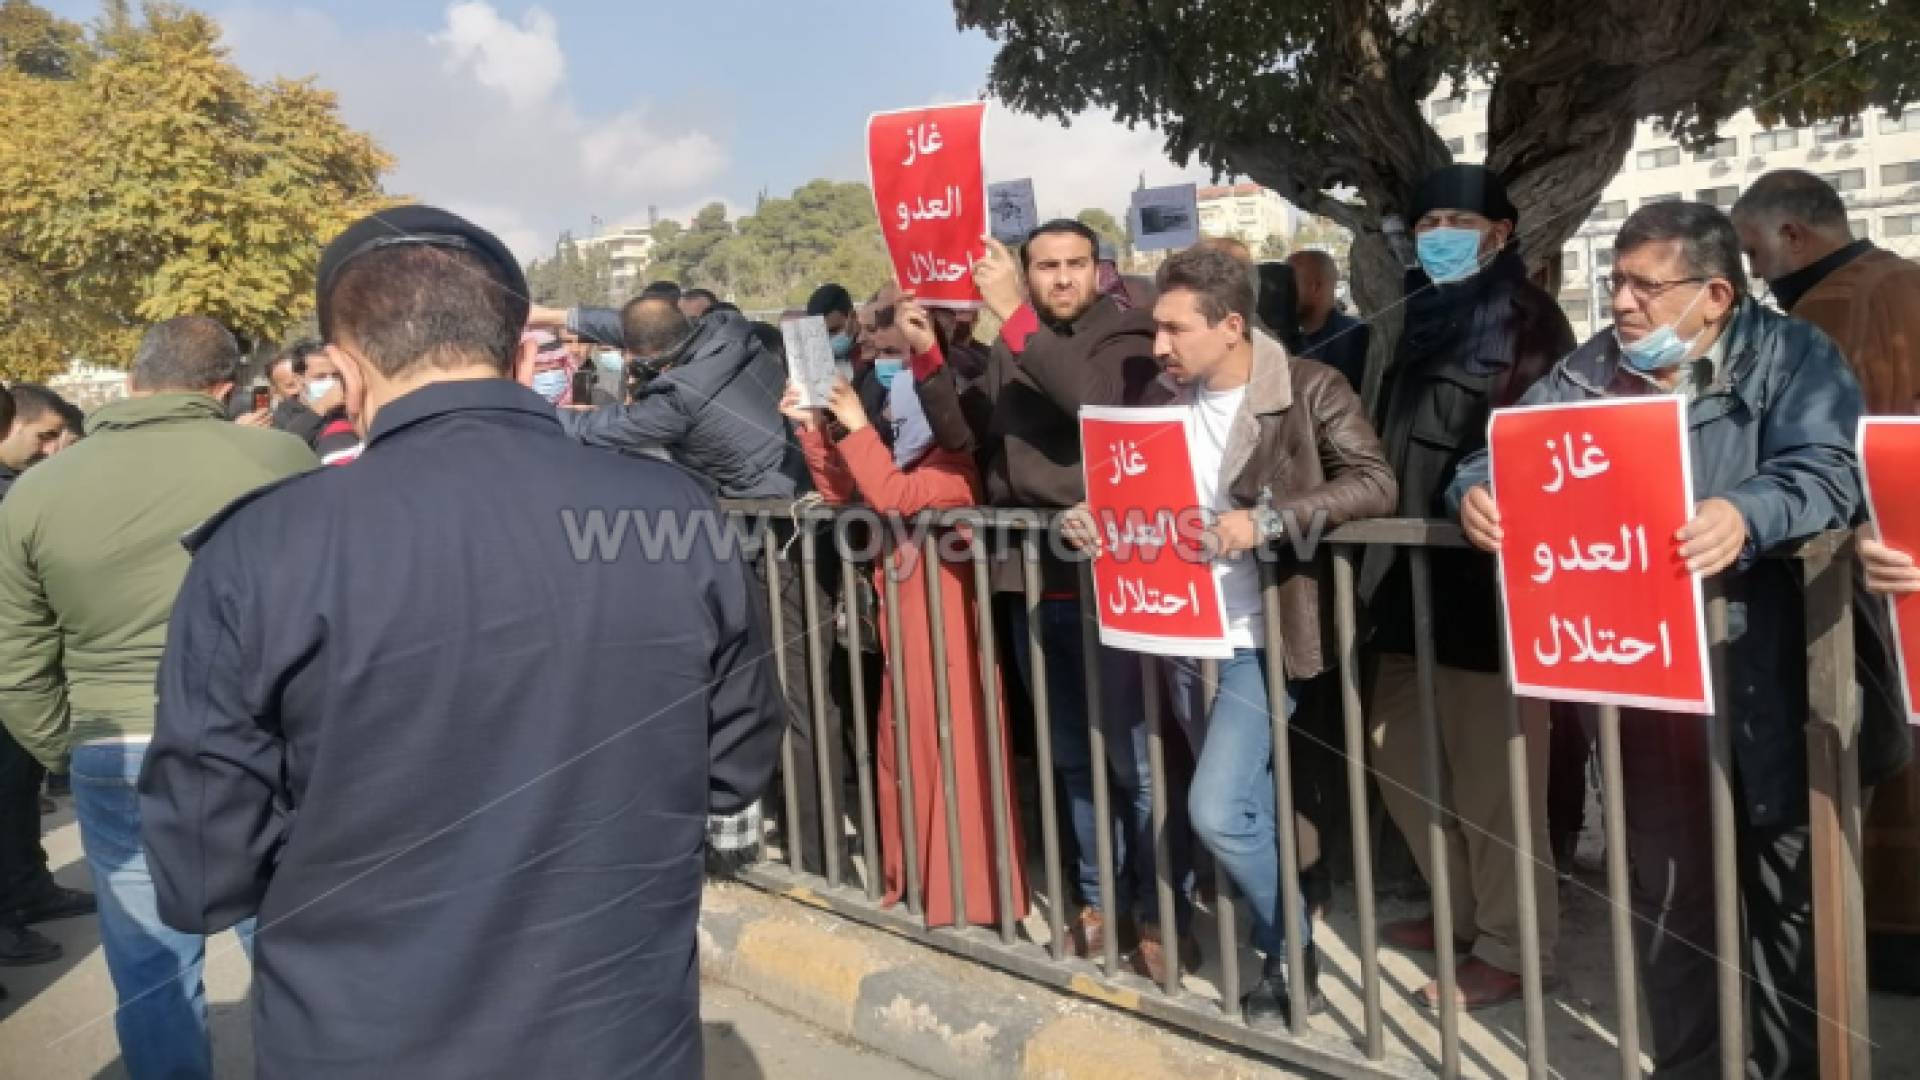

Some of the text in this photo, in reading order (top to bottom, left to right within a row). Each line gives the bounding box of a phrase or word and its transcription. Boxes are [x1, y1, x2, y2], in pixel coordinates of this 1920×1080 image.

[901, 122, 943, 165] غاز
[896, 185, 962, 231] العدو
[907, 250, 973, 285] احتلال
[1109, 440, 1148, 485] غاز
[1541, 431, 1610, 492] غاز
[1104, 509, 1178, 553] العدو
[1531, 524, 1649, 583] العدو
[1109, 575, 1200, 617] احتلال
[1533, 613, 1673, 668] احتلال
